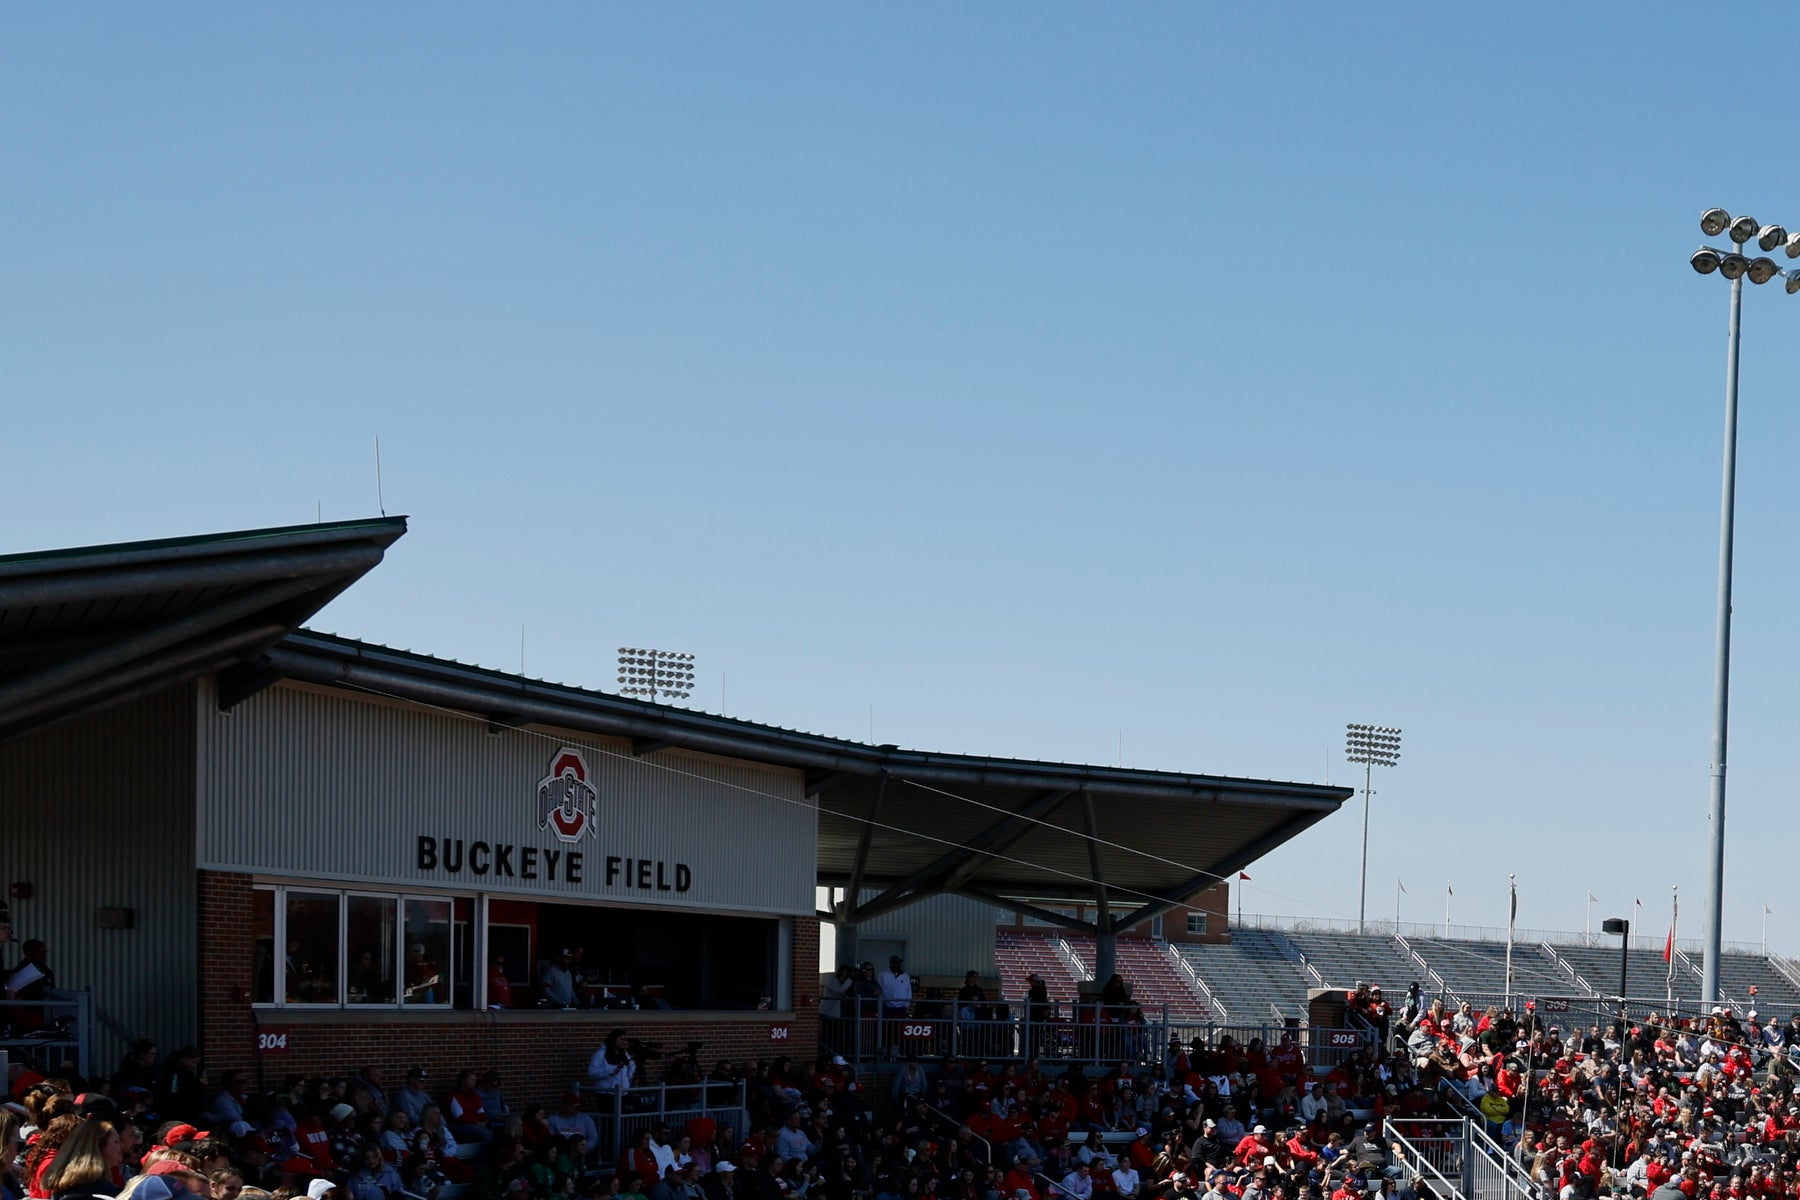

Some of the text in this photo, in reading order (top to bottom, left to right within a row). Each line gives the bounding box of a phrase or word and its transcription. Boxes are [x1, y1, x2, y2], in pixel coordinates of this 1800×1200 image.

[417, 835, 692, 893] BUCKEYE FIELD
[771, 1027, 788, 1039] 304
[903, 1025, 932, 1037] 305
[258, 1033, 288, 1049] 304
[1331, 1034, 1356, 1046] 305
